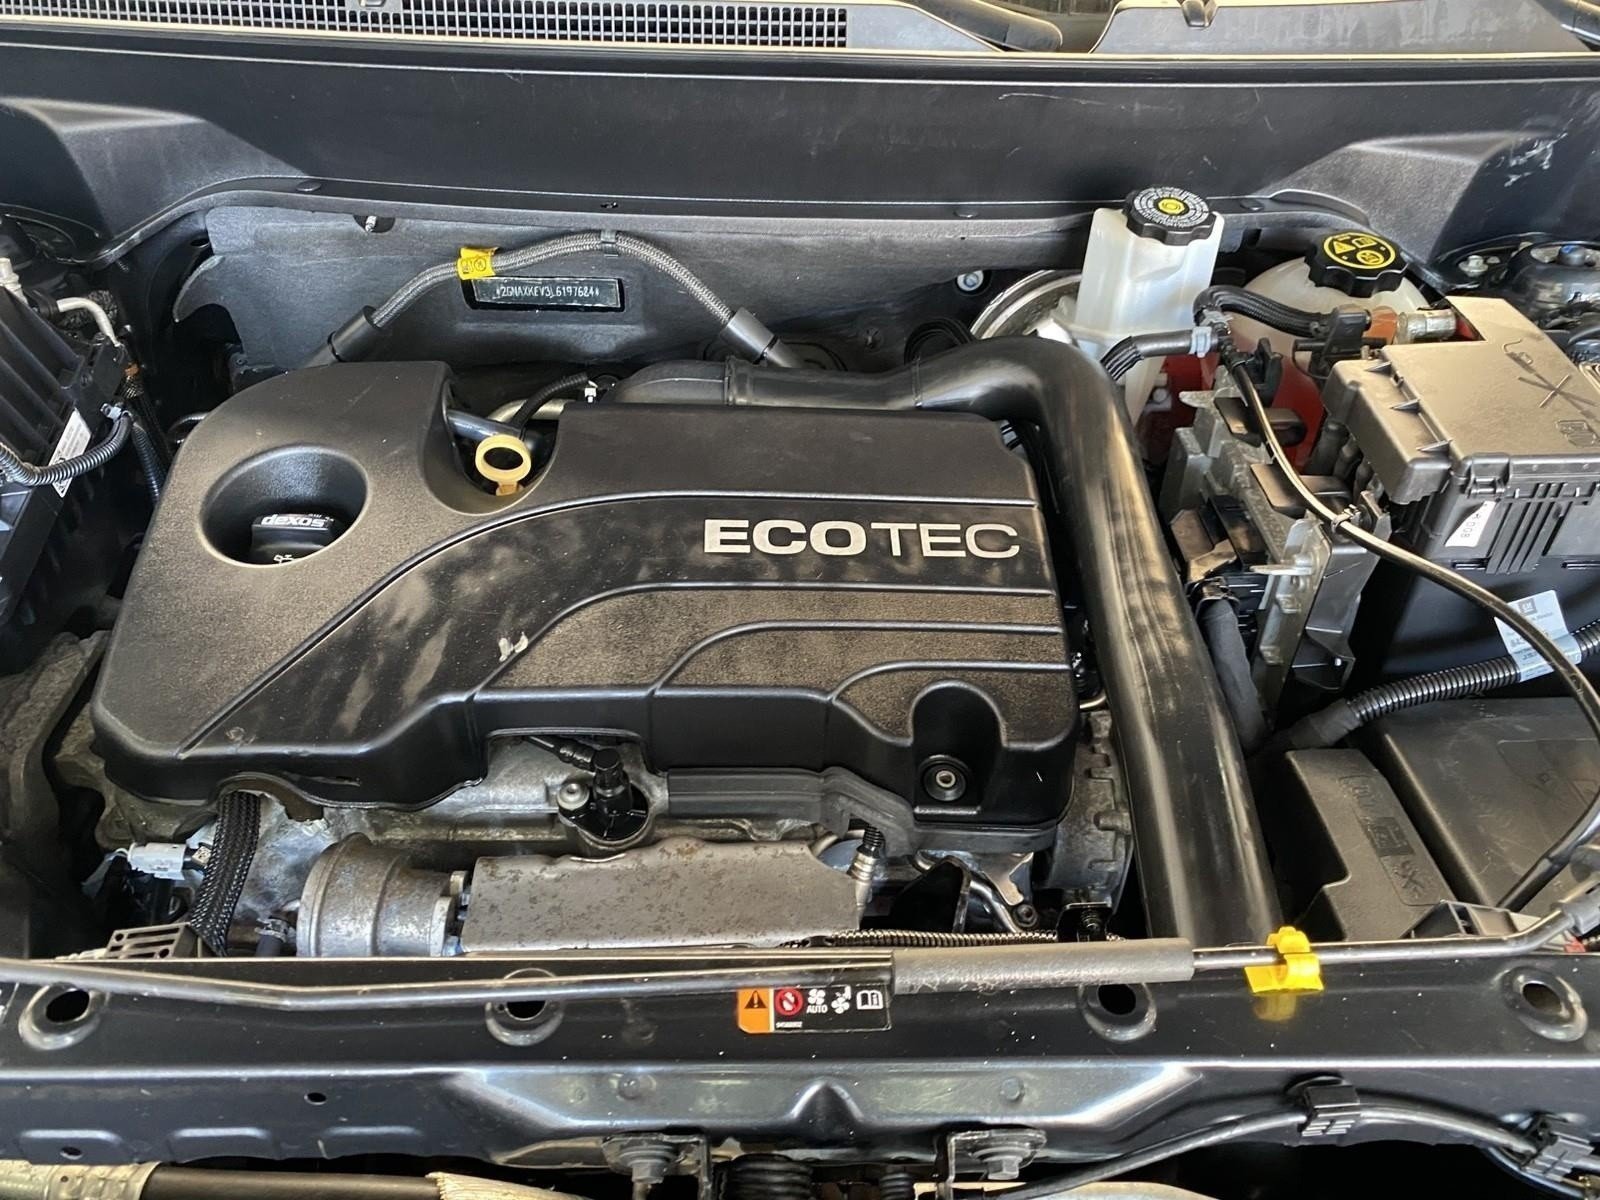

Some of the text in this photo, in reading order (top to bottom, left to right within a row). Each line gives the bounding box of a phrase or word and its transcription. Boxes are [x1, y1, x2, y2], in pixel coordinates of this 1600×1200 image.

[261, 514, 325, 528] dexos
[704, 519, 1020, 559] ECOTEC
[807, 1005, 828, 1014] AUTO
